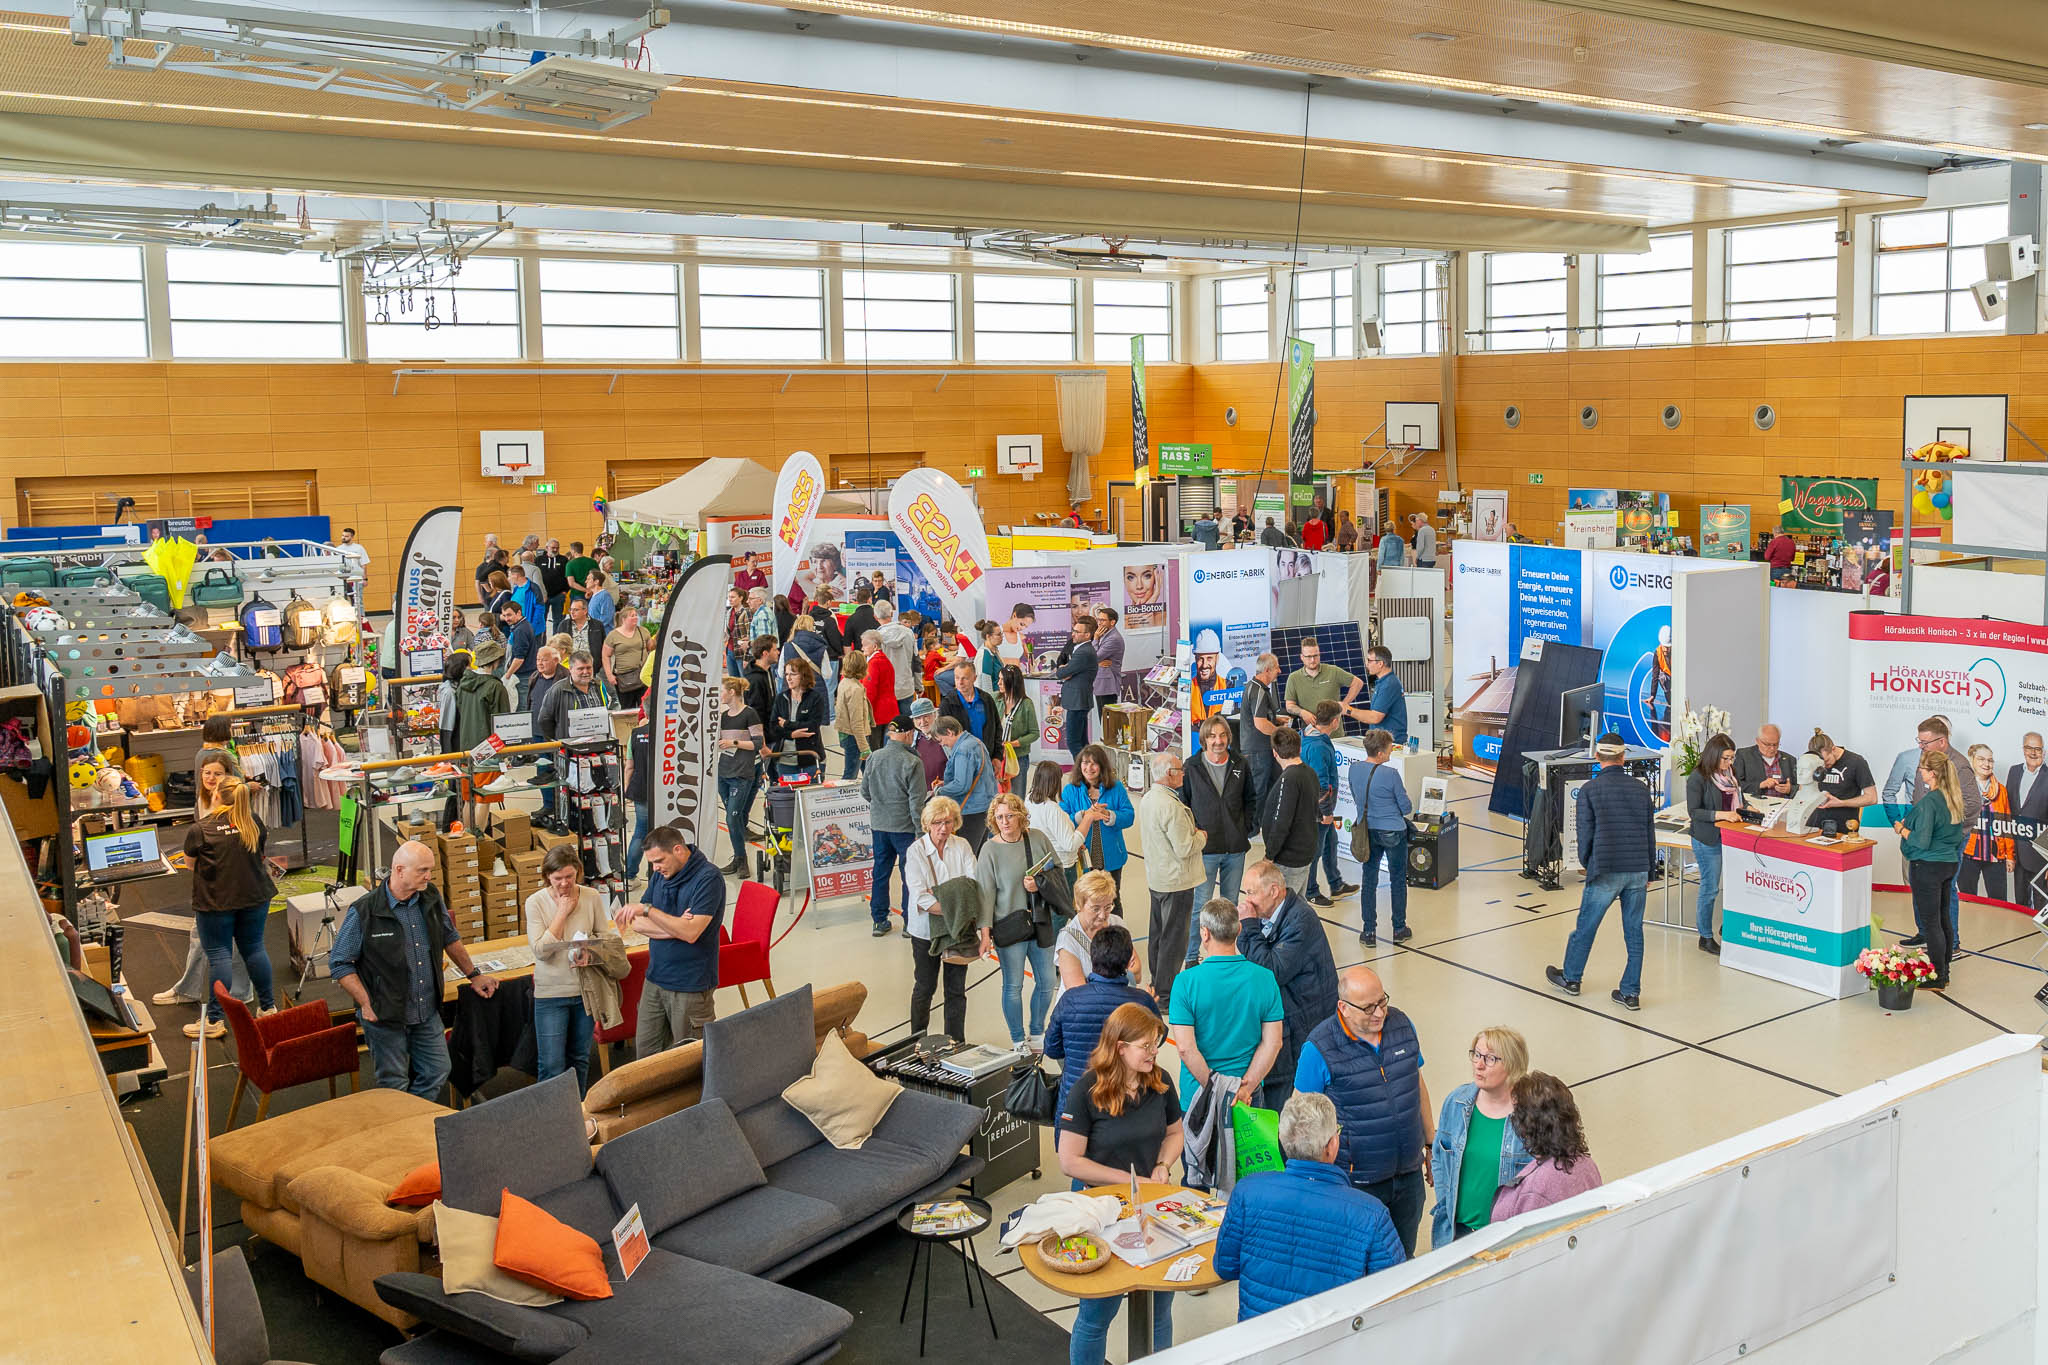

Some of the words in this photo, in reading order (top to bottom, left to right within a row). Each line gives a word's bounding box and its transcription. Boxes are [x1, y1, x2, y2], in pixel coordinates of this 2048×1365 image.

[1162, 452, 1190, 461] RASS
[788, 469, 814, 532] ASB
[1790, 481, 1865, 516] Wagneria
[731, 524, 771, 539] FÜHRER
[1573, 526, 1614, 534] freinsheim
[1206, 570, 1238, 580] ENERGIE
[1240, 568, 1264, 578] FABRIK
[1522, 569, 1550, 580] Erneuere
[1551, 572, 1569, 581] Deine
[1518, 581, 1543, 592] Energie,
[1545, 586, 1573, 594] erneuere
[407, 568, 420, 637] ORTHAUS
[1520, 593, 1538, 602] Deine
[1539, 594, 1554, 604] Welt
[1561, 598, 1571, 606] mit
[1127, 604, 1163, 614] Bio-Botox
[1522, 606, 1569, 619] wegweisenden,
[1524, 619, 1567, 630] regenerativen
[1530, 630, 1561, 641] Lösungen.
[1884, 626, 1925, 635] Hörakustik
[1928, 627, 1957, 637] Honisch
[1966, 630, 1971, 638] 3
[1980, 631, 1986, 639] in
[1988, 631, 2000, 640] der
[2003, 633, 2025, 644] Region
[1889, 665, 1970, 681] HÖRAKUSTIK
[1870, 672, 1970, 696] HONISCH
[2018, 681, 2048, 692] Sulzbach-
[1209, 693, 1227, 701] JETZT
[2019, 693, 2041, 704] Pegnitz
[2018, 706, 2046, 716] Auerbach
[662, 655, 681, 786] SPORTHAUS
[811, 805, 871, 819] SCHUH-WOCHEN
[1993, 820, 2033, 838] gutes
[816, 876, 834, 887] 10€
[840, 873, 858, 884] 20€
[1754, 868, 1794, 884] HÖRAKUSTIK
[1746, 871, 1794, 895] HONISCH
[1742, 932, 1757, 941] Wieder
[1750, 922, 1763, 933] Ihre
[1764, 925, 1807, 943] Hörexperten
